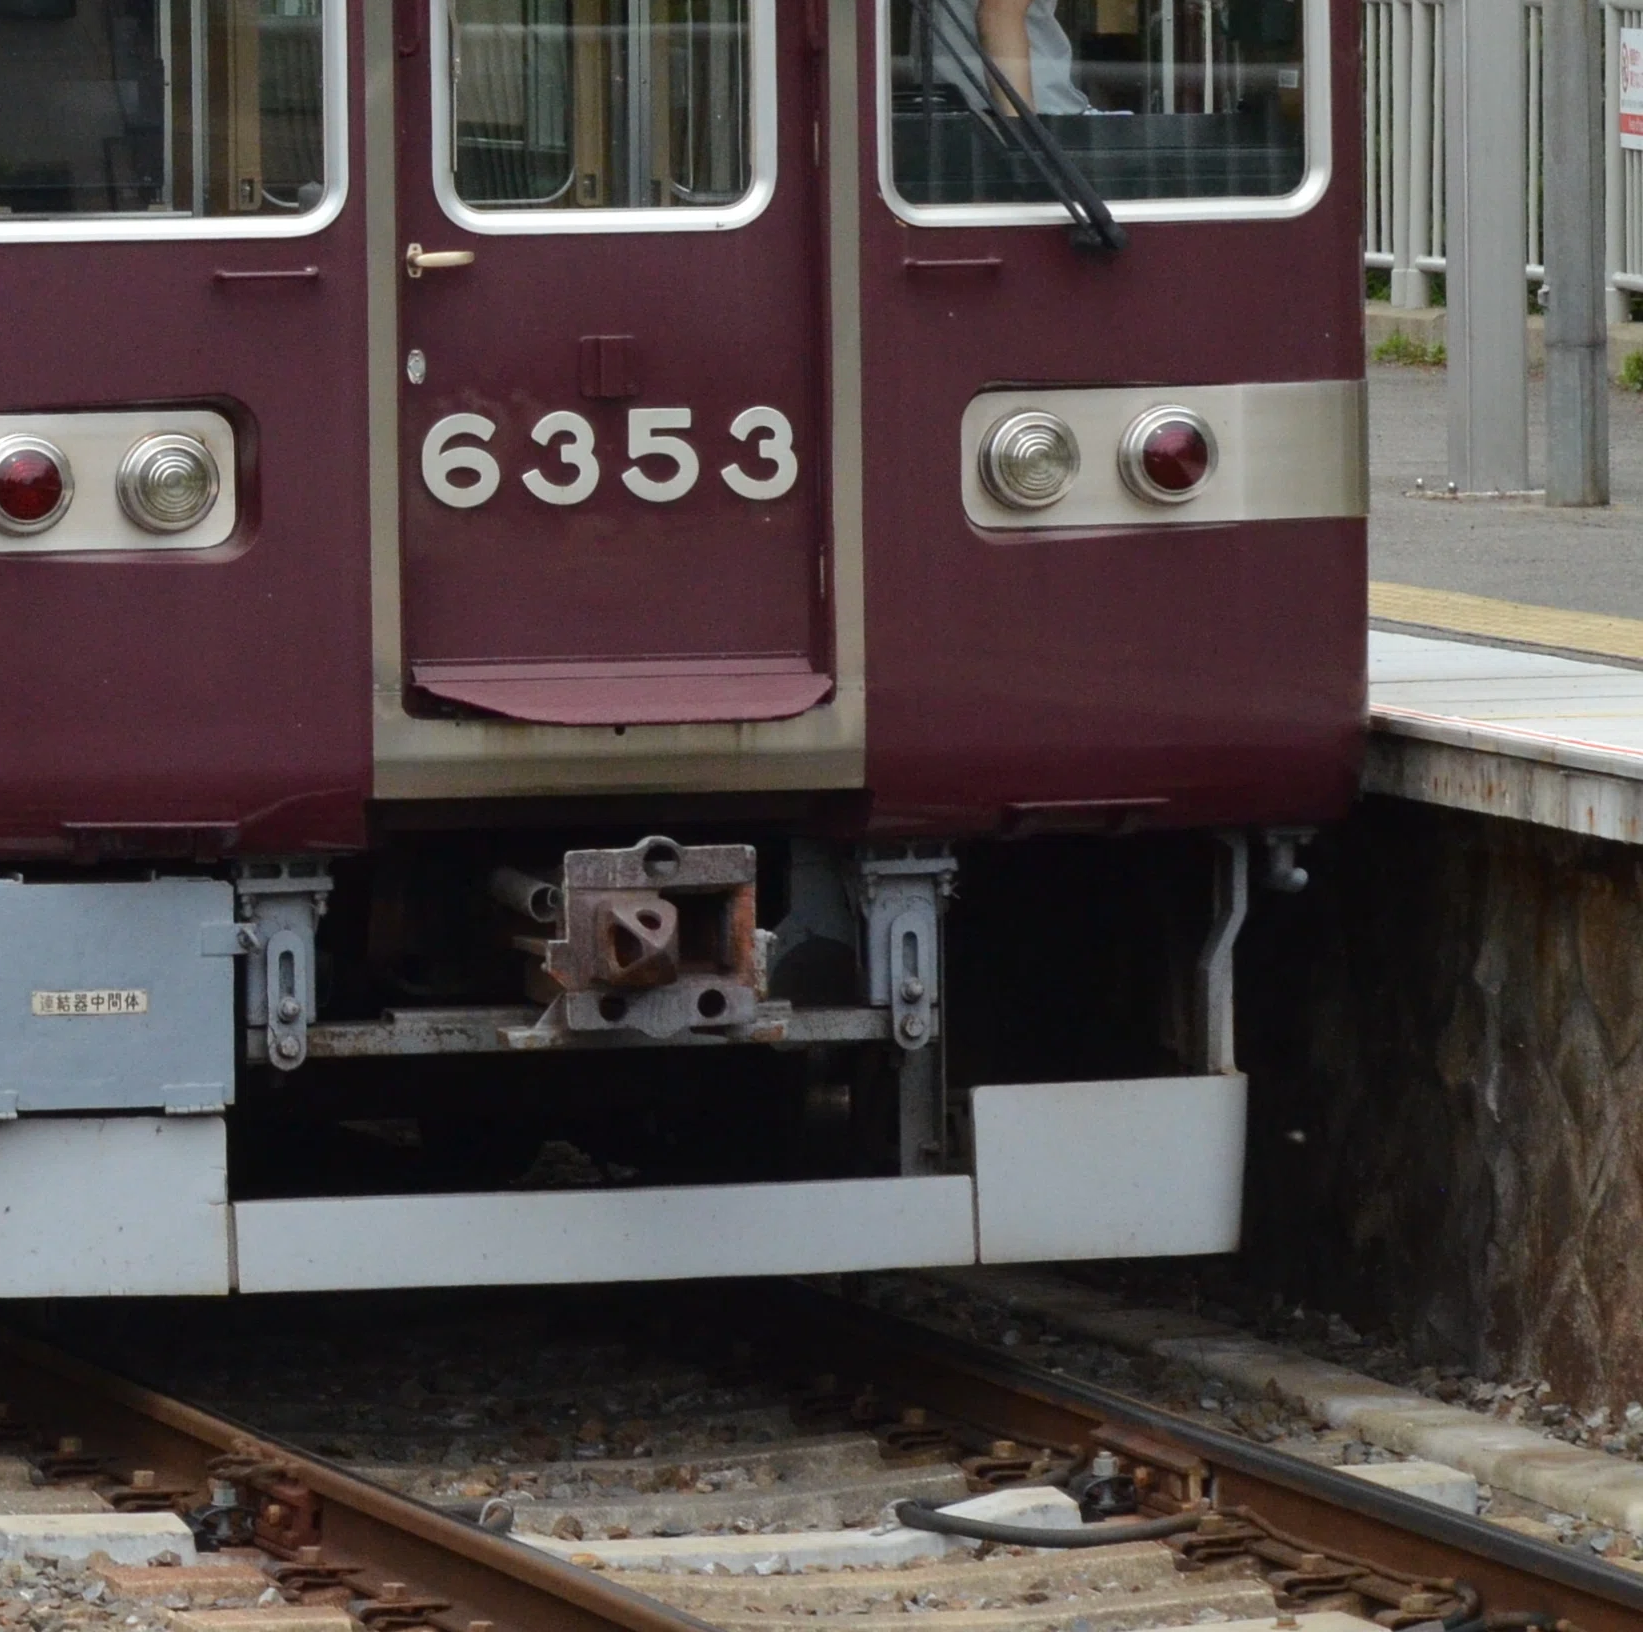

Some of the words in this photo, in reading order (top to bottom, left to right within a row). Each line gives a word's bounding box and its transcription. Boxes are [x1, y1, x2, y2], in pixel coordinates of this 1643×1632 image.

[421, 406, 798, 508] 6353
[40, 992, 139, 1013] 連結器中間体
